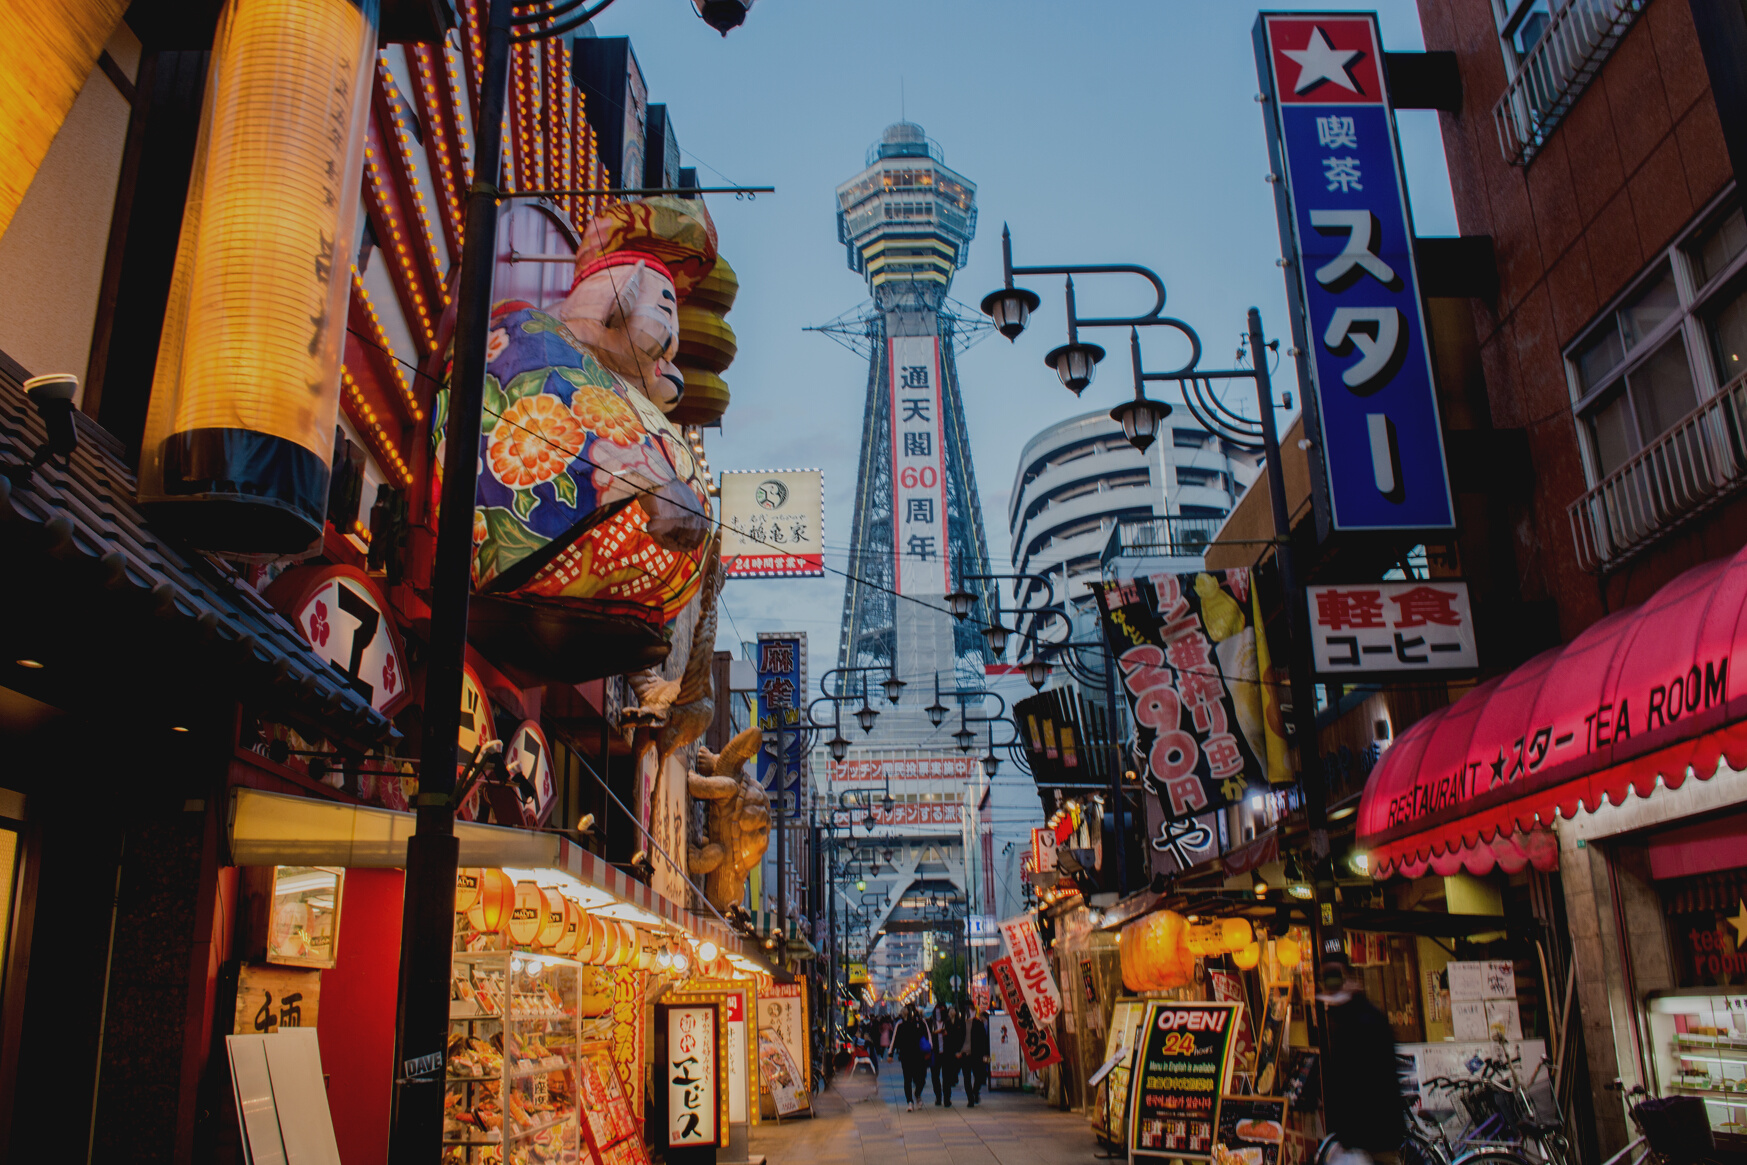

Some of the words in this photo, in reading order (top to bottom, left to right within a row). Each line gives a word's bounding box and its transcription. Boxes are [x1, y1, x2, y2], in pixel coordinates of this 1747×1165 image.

[1315, 116, 1364, 194] 喫茶
[1309, 209, 1406, 500] スター
[1315, 586, 1462, 631] 軽食
[1326, 632, 1461, 665] コーヒー
[759, 641, 796, 709] 麻雀
[1118, 643, 1208, 817] 290円
[1387, 761, 1482, 830] RESTAURANT
[1508, 725, 1574, 784] スター
[1584, 699, 1631, 755] TEA
[1647, 656, 1729, 733] ROOM
[1688, 928, 1726, 953] tea
[1021, 961, 1058, 1020] どて焼
[1157, 1010, 1228, 1033] OPEN!
[1163, 1032, 1195, 1057] 24
[1194, 1044, 1213, 1057] hours
[407, 1054, 442, 1076] DAVE
